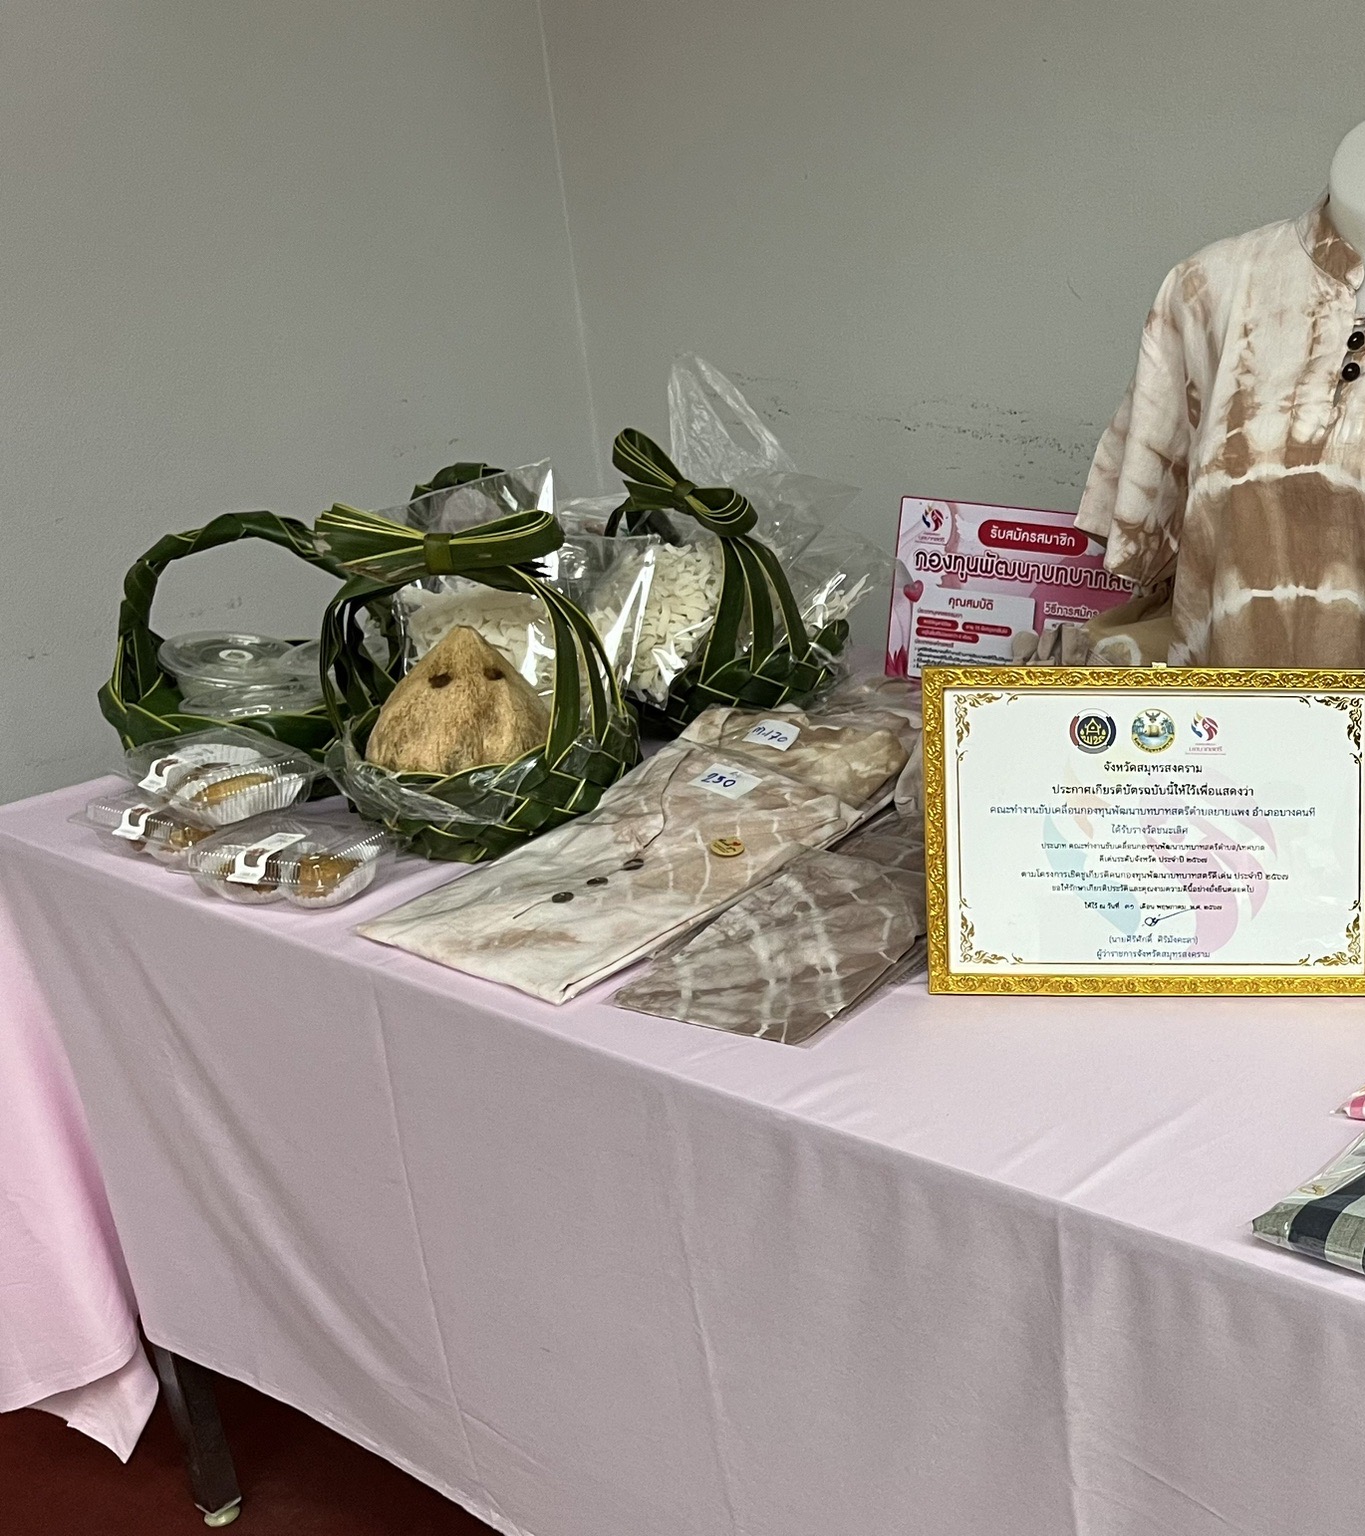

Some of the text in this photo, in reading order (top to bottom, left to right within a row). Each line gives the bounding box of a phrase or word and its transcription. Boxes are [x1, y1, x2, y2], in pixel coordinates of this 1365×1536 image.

[989, 525, 1076, 547] รับสมัครสมาชิก
[914, 551, 1135, 591] กองทุนพัฒนาบทบาทสต
[948, 596, 994, 611] คุณสมบัติ
[1103, 761, 1203, 776] จังหวัดสมุทรสงคราม
[700, 772, 737, 787] 250
[1052, 782, 1254, 796] ประกาศเกียรติบัตรฉบับนี้ให้ไว้เพื่อแสดงว่า
[1252, 806, 1316, 817] อำเภอบางคนที
[1111, 823, 1188, 835] ได้รับรางวัลชนะเลิศ
[1234, 871, 1263, 880] ประจำปี
